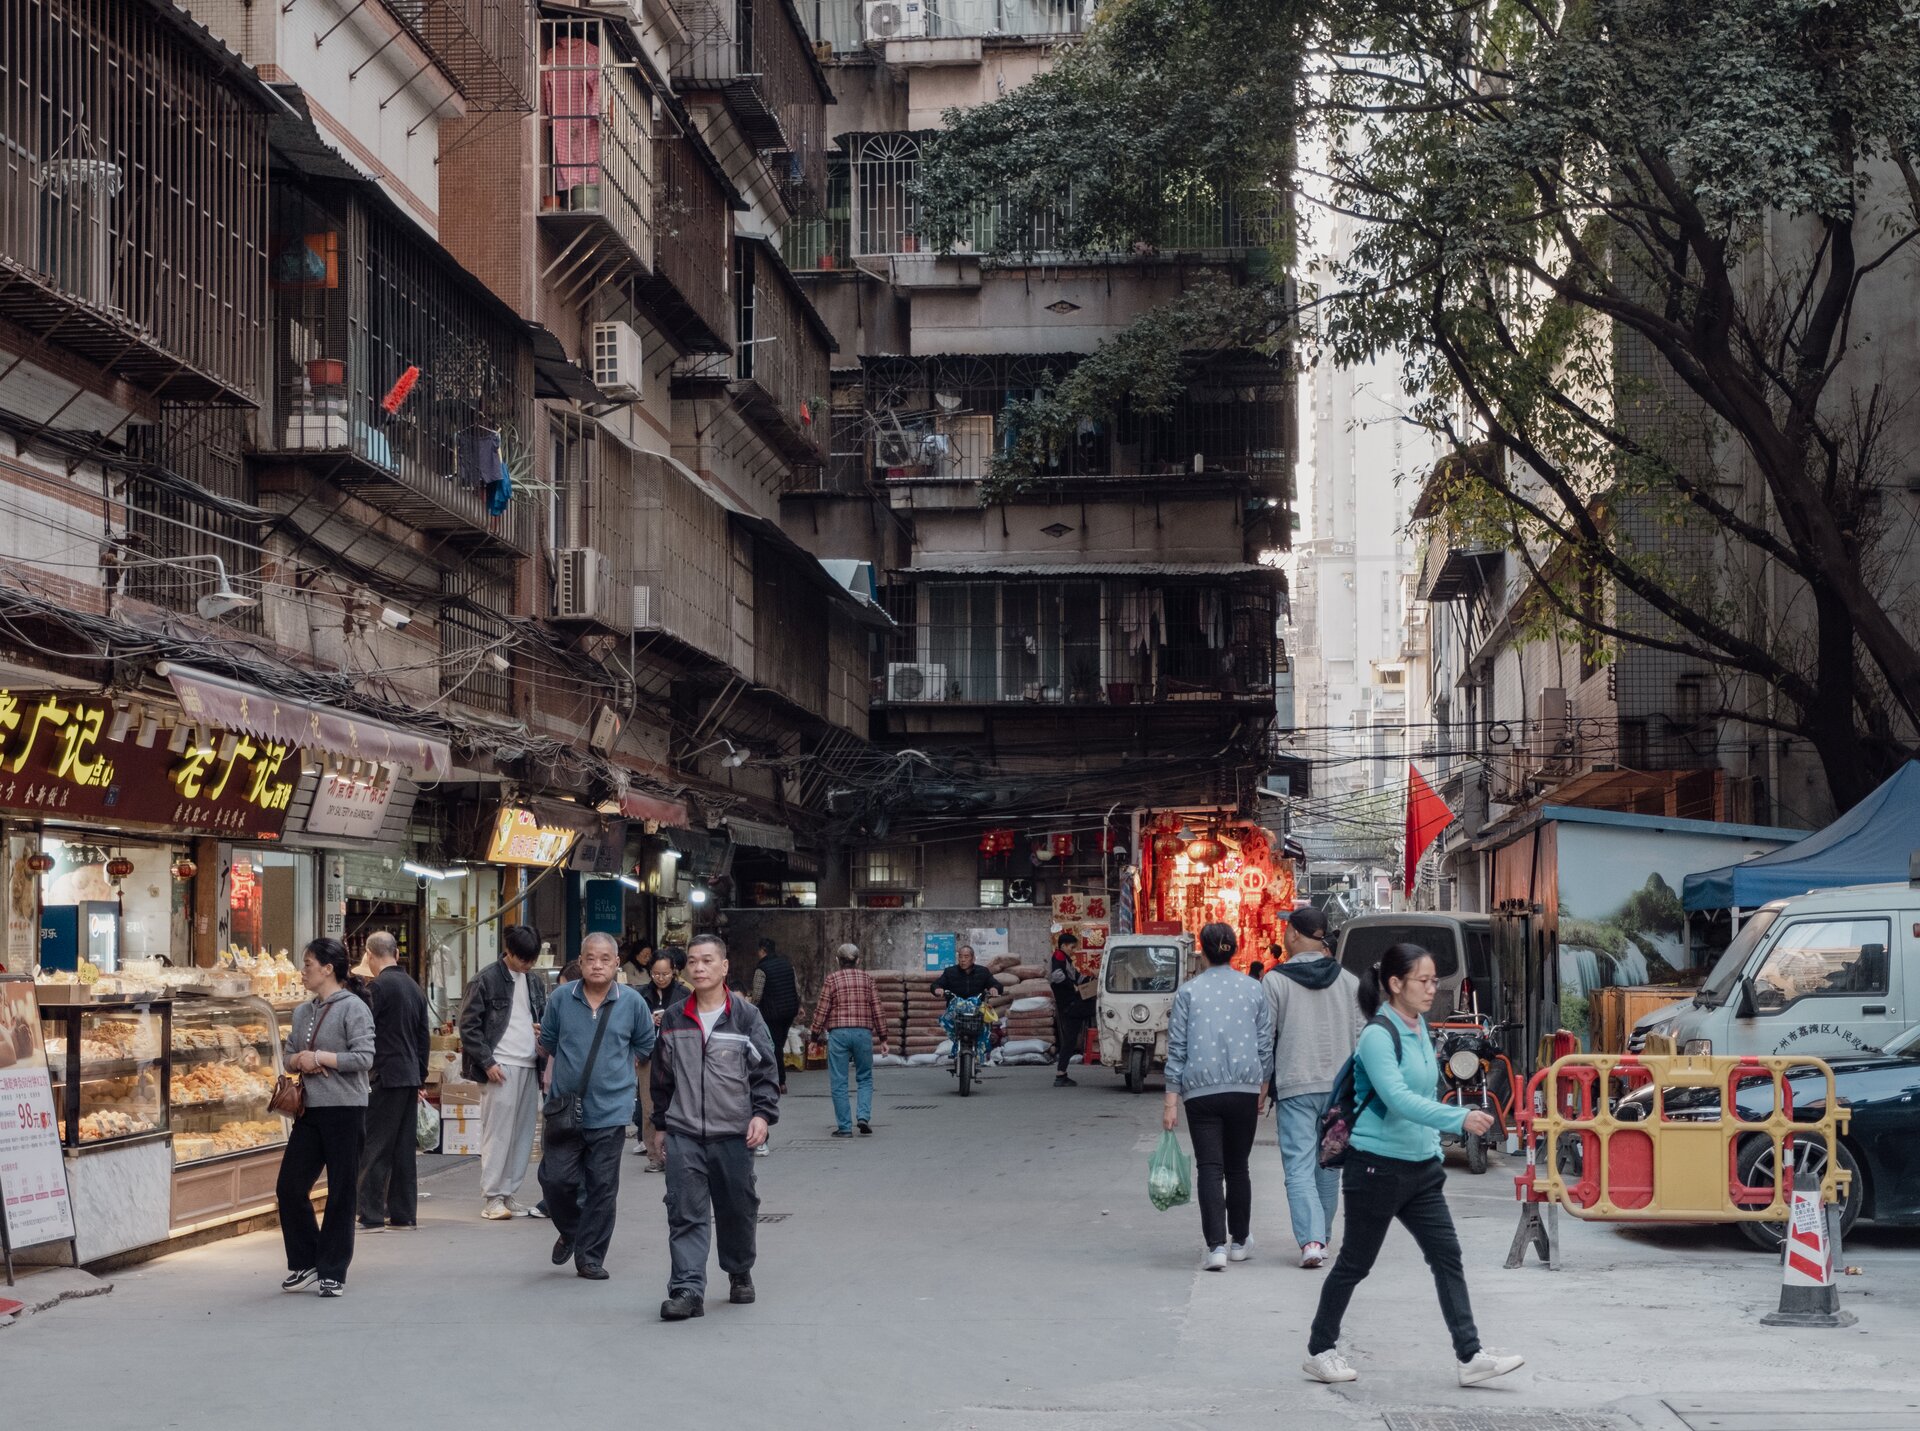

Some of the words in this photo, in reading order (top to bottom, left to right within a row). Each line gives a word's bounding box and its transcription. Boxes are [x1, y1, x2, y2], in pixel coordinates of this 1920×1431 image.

[87, 755, 114, 787] 点心
[177, 735, 286, 808] 老广记
[1087, 897, 1106, 919] 福
